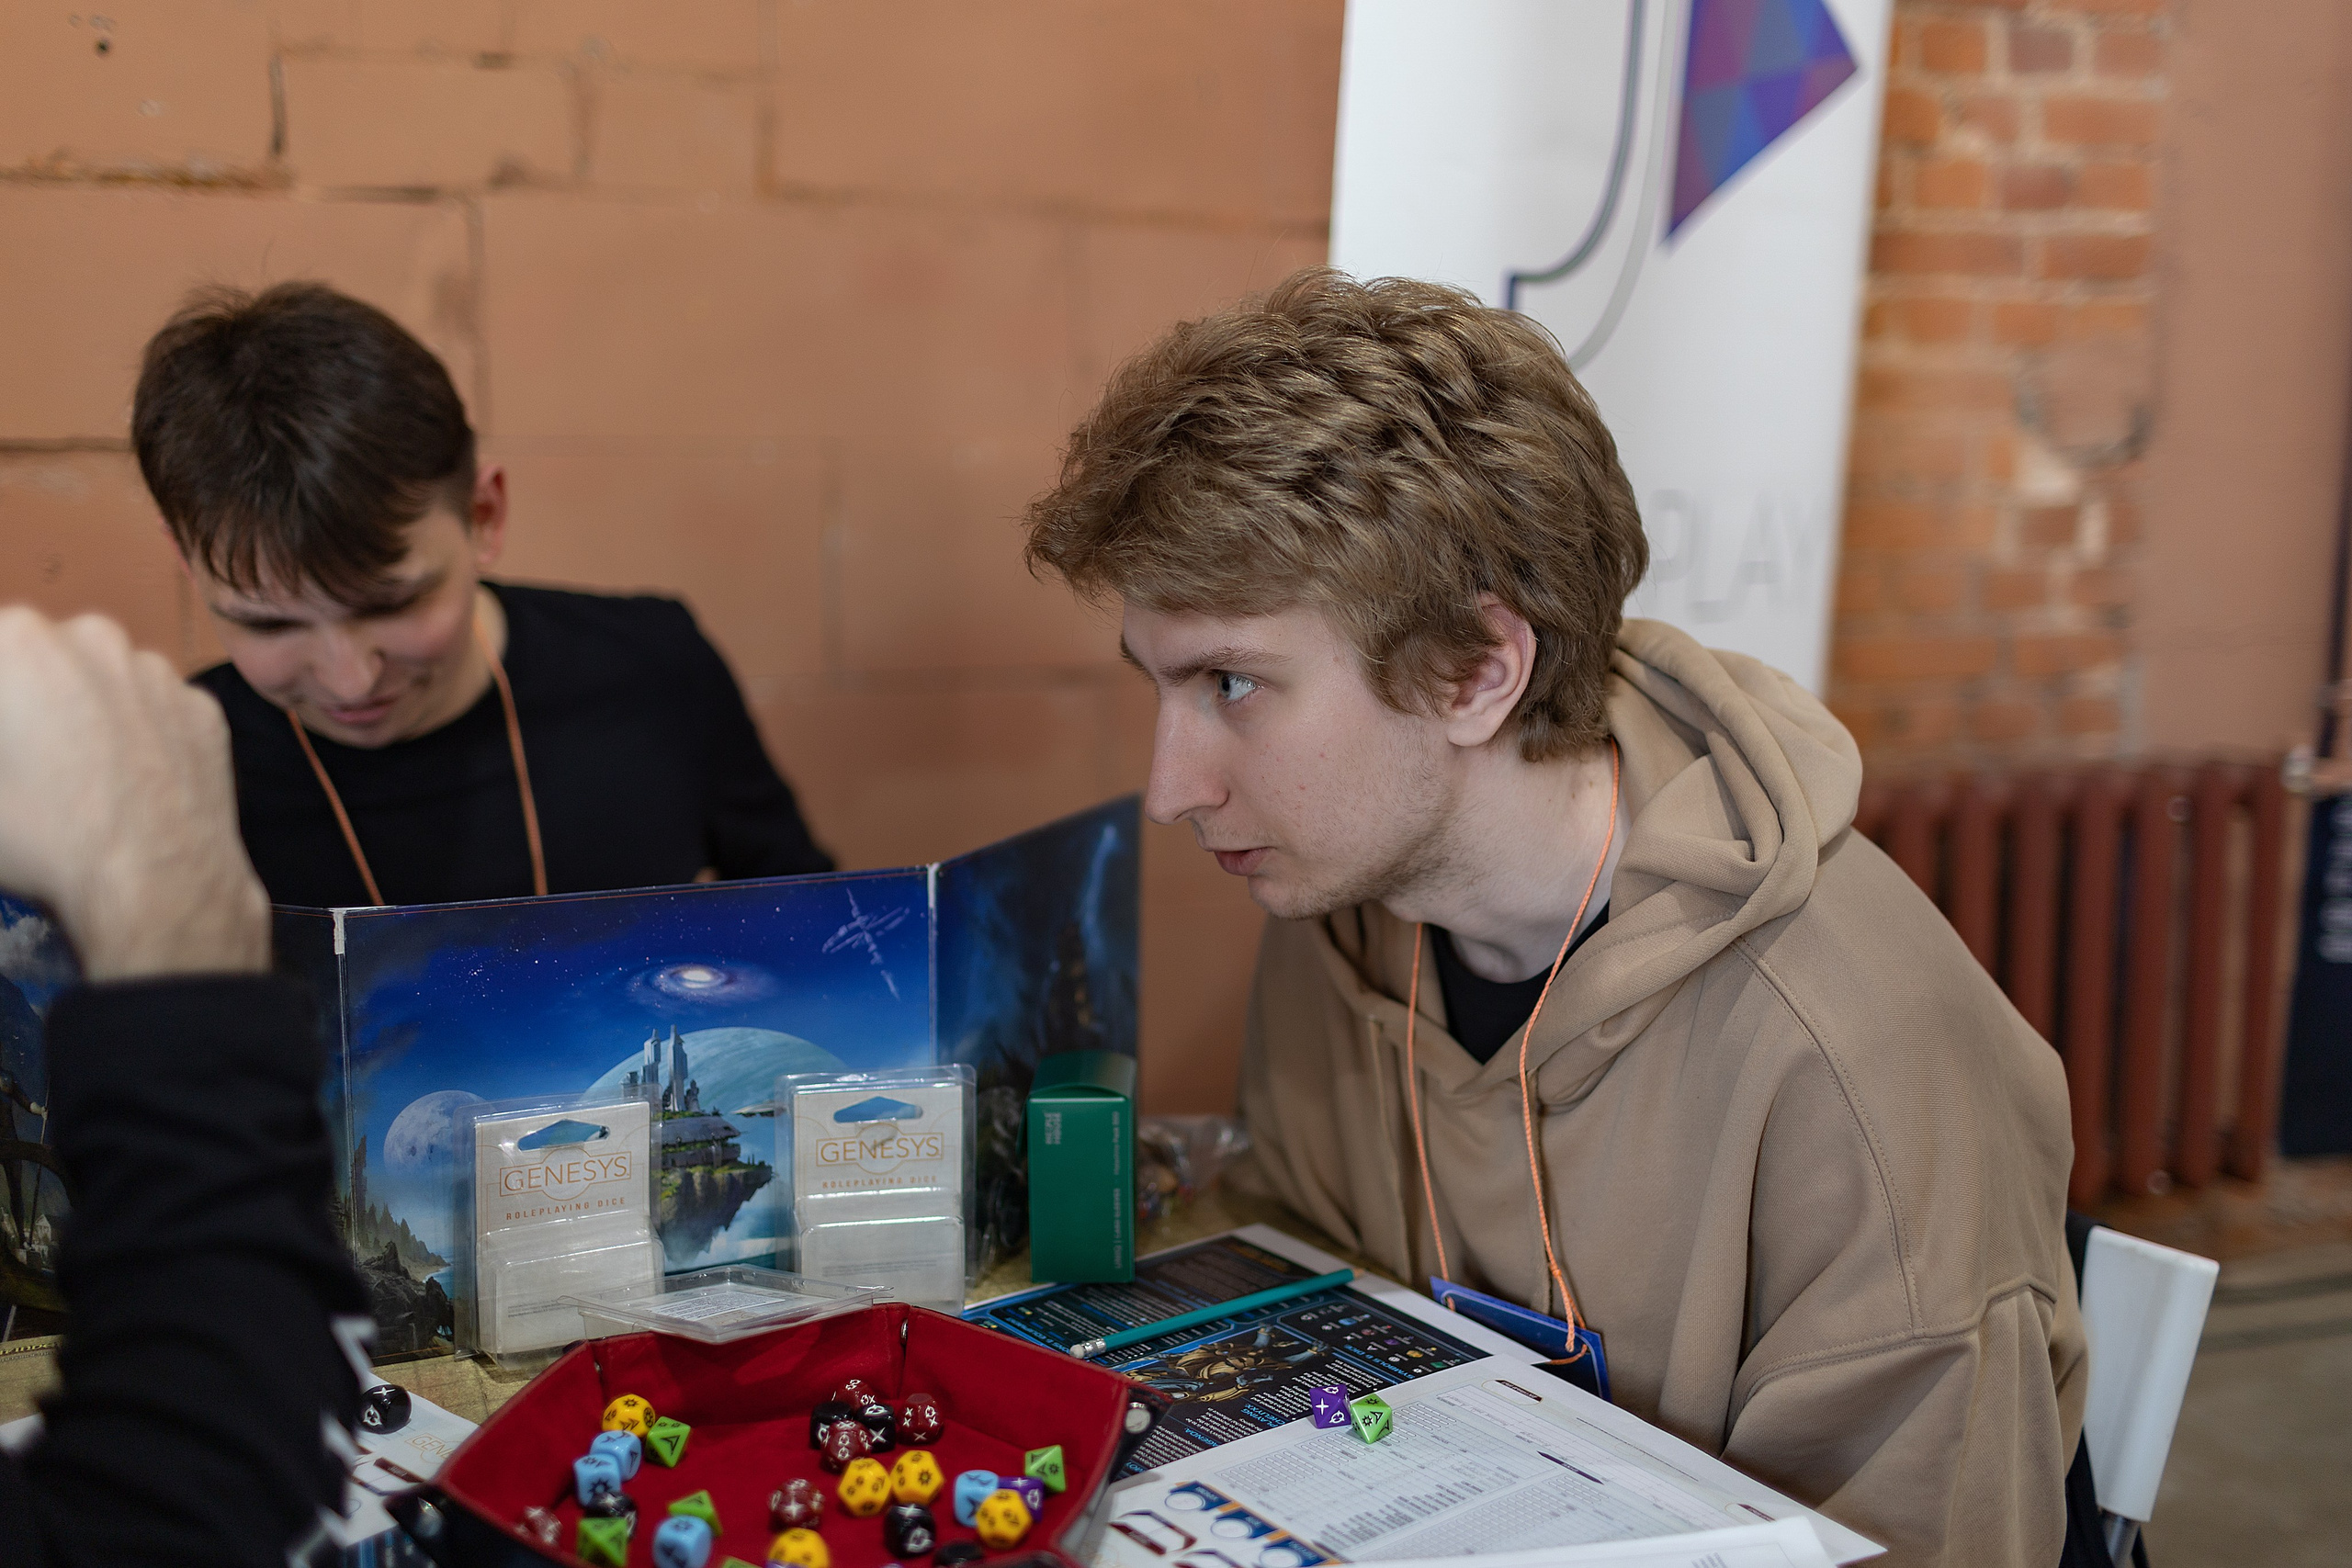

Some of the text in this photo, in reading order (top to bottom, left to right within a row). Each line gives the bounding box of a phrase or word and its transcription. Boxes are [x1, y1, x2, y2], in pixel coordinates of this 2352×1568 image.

[820, 1135, 941, 1163] GENESYS
[503, 1156, 630, 1191] GENESYS
[822, 1177, 902, 1190] ROLEPLAYING
[506, 1197, 626, 1220] ROLEPLAYING DICE
[1240, 1408, 1279, 1428] PLAYING
